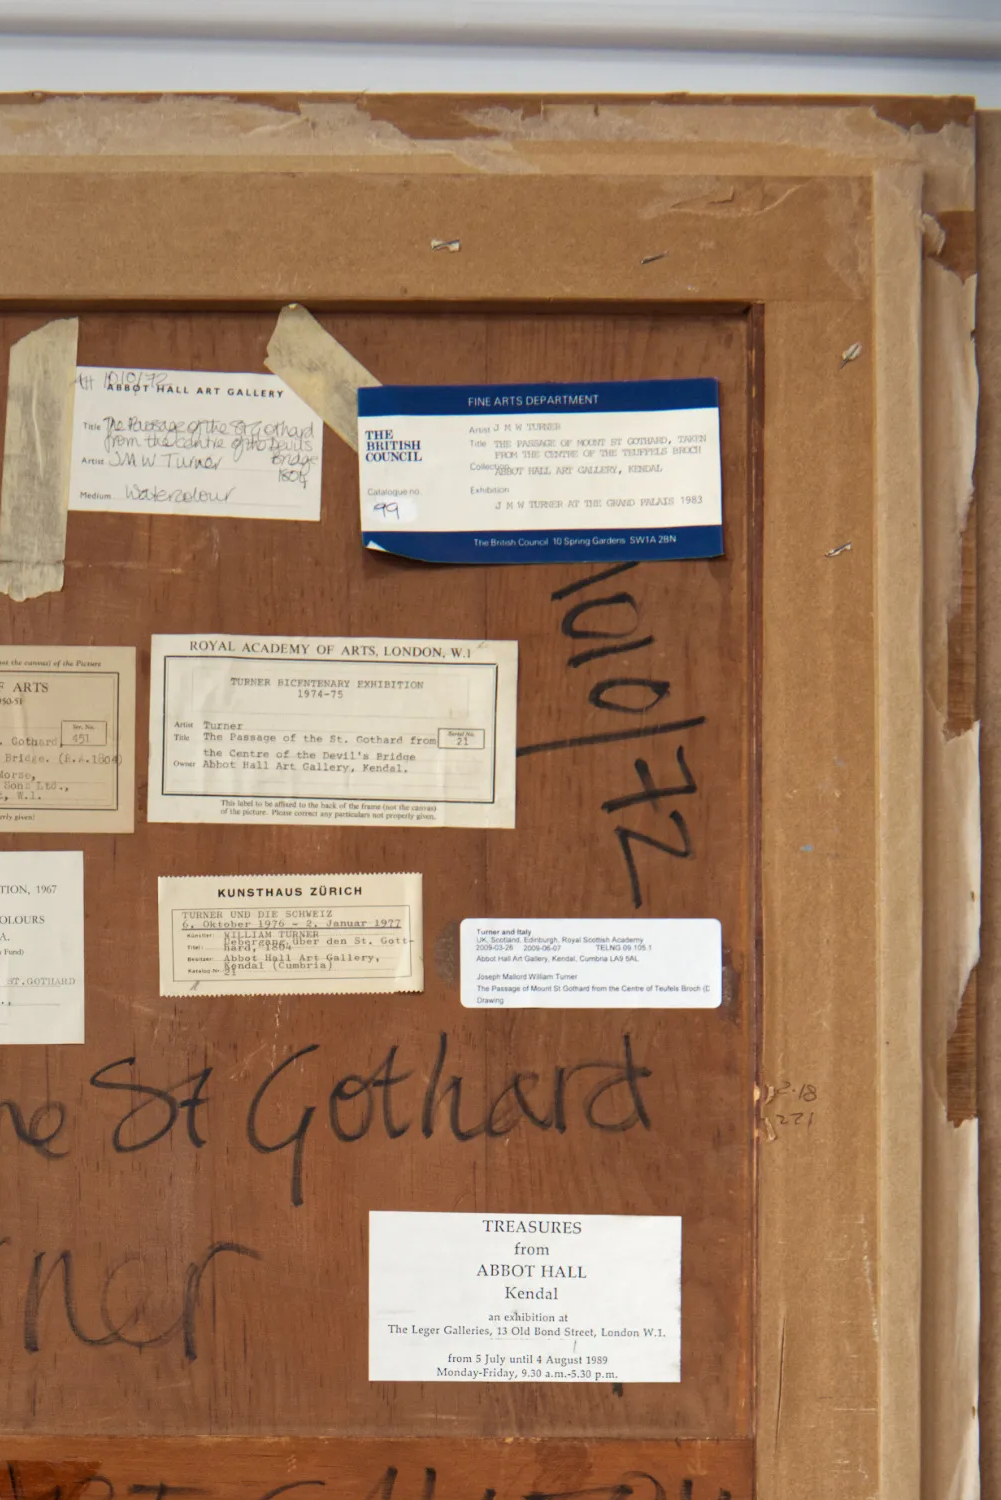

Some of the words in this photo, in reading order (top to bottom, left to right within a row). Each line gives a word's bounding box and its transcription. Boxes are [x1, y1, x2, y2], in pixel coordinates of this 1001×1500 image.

[107, 384, 149, 392] ABBOT
[156, 385, 189, 394] HALL
[197, 387, 220, 395] ART
[228, 389, 283, 398] GALLERY
[365, 430, 394, 440] THE
[366, 440, 421, 450] BRITISH
[365, 451, 422, 462] COUNCIL
[189, 641, 235, 652] ROYAL
[242, 642, 310, 654] ACADEMY
[317, 644, 335, 655] OF
[341, 646, 380, 658] ARTS,
[384, 646, 446, 659] LONDON,
[13, 682, 49, 692] ARTS
[230, 678, 271, 688] TURNER
[277, 678, 350, 689] BICENTENARY
[357, 679, 424, 689] EXHIBITION
[297, 689, 344, 699] 1974-75
[456, 737, 469, 746] 21
[36, 885, 57, 894] 1967
[218, 887, 303, 898] KUNSTHAUS
[310, 886, 363, 897] ZÜRICH
[108, 1055, 213, 1156] St
[248, 1035, 651, 1206] Gothard
[482, 1220, 582, 1234] TREASURES
[514, 1242, 550, 1256] from
[476, 1265, 535, 1278] ABBOT
[541, 1266, 587, 1279] HALL
[504, 1287, 558, 1300] Kendal
[488, 1313, 500, 1321] an
[504, 1312, 556, 1322] exhibition
[559, 1314, 568, 1322] at
[388, 1324, 408, 1335] The
[412, 1325, 440, 1337] Leger
[444, 1325, 493, 1337] Galleries,
[497, 1327, 507, 1336] 13
[511, 1327, 530, 1337] Old
[534, 1327, 560, 1337] Bond
[564, 1327, 597, 1338] Street,
[601, 1328, 639, 1338] London
[448, 1354, 472, 1364] from
[476, 1354, 481, 1364] 5
[485, 1354, 505, 1366] July
[509, 1354, 532, 1364] until
[536, 1355, 542, 1364] 4
[546, 1355, 582, 1366] August
[586, 1355, 607, 1365] 1989
